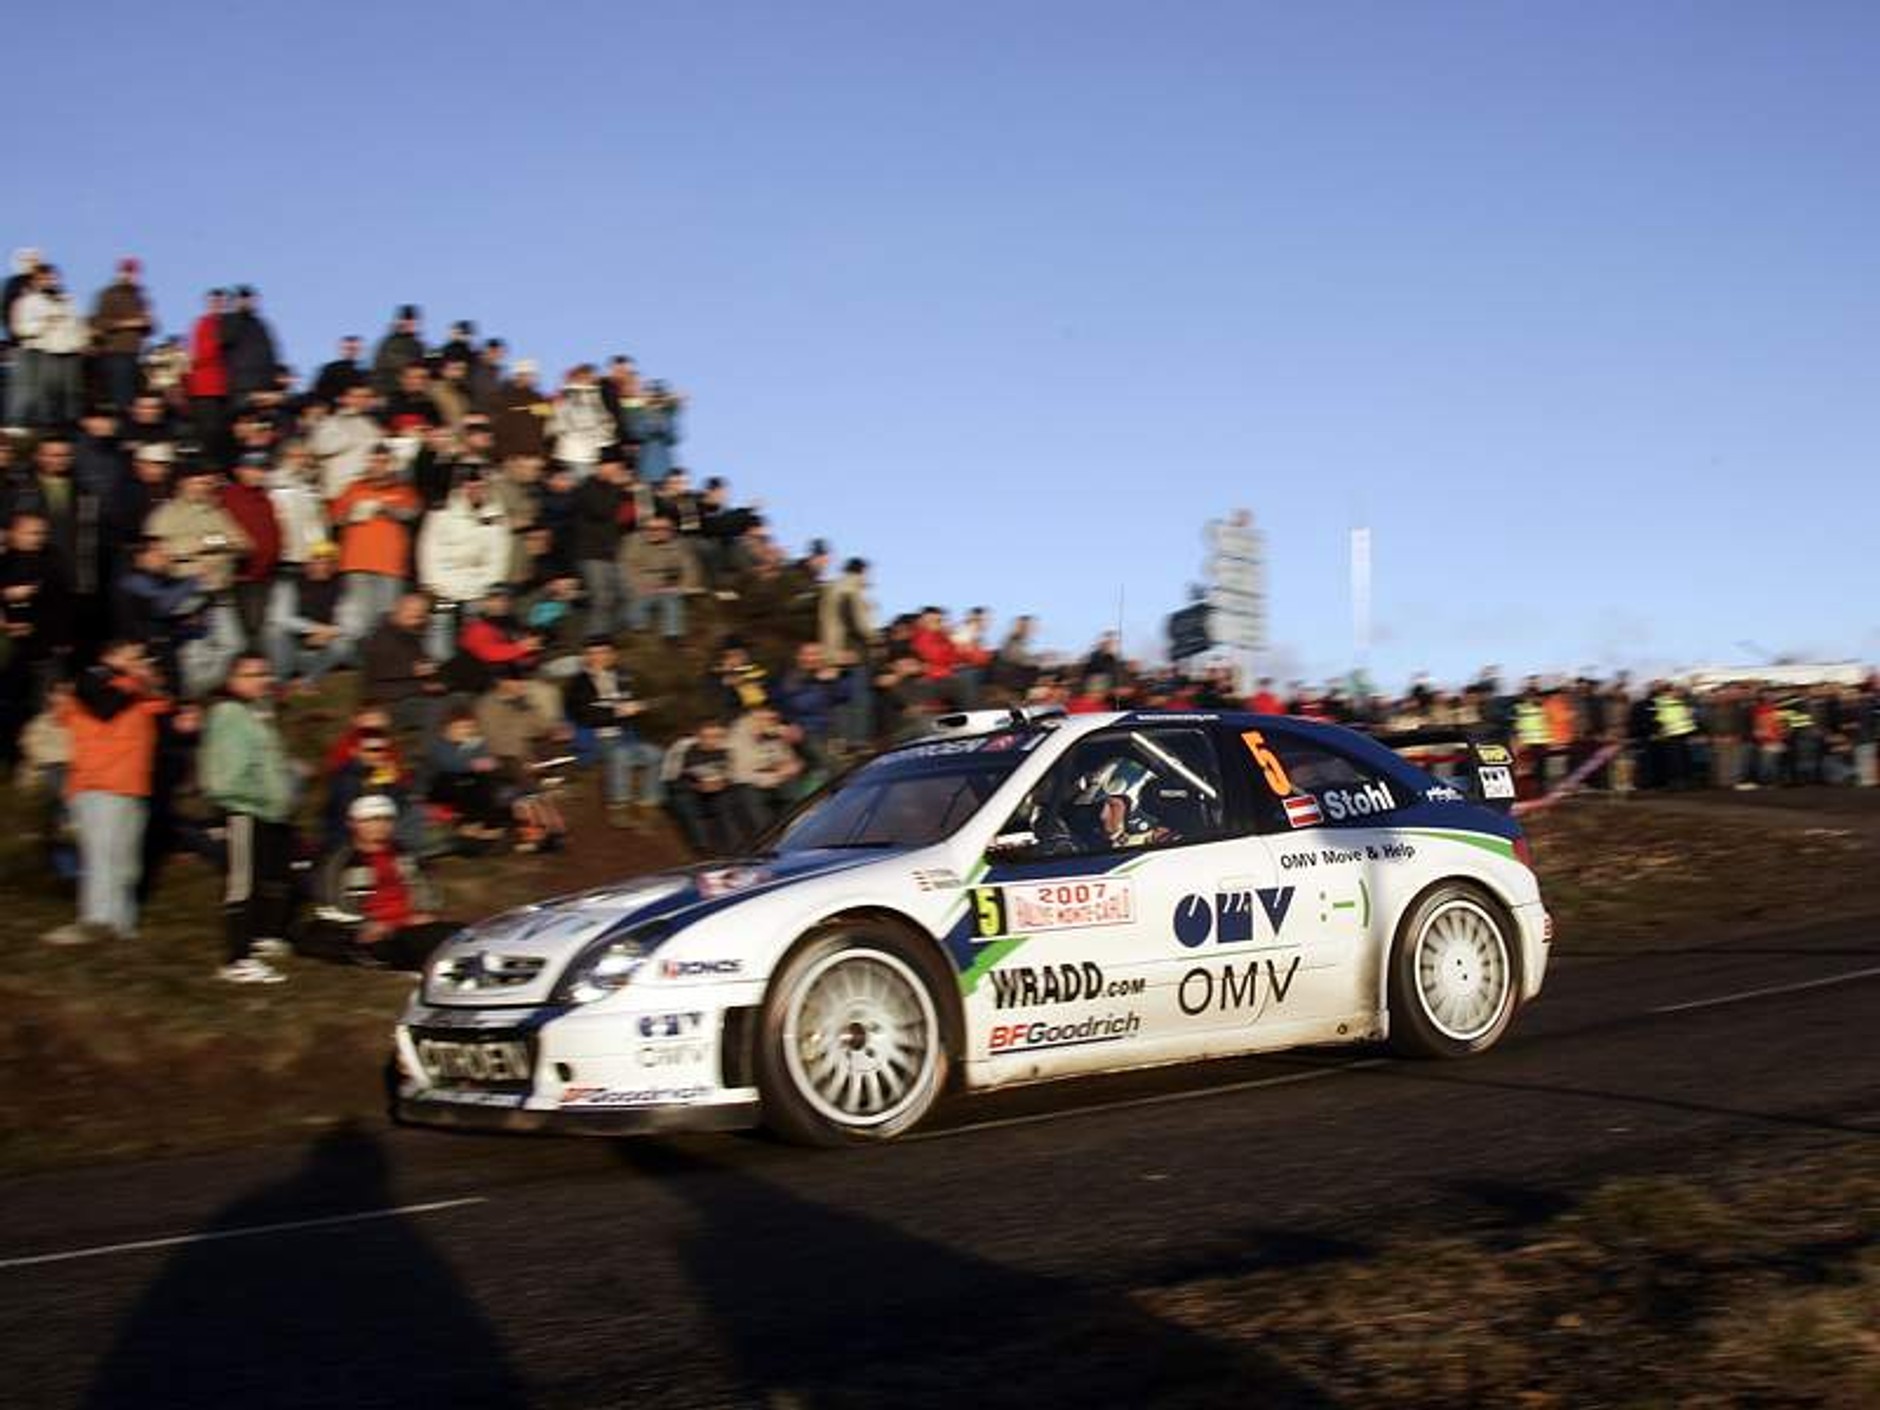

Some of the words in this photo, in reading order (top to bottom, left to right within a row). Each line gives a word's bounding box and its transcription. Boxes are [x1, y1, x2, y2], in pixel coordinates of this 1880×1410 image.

[1240, 731, 1293, 796] 5
[1323, 780, 1395, 820] Stohl
[1280, 853, 1317, 869] OMV
[1322, 849, 1362, 864] Move
[1381, 842, 1417, 860] Help
[976, 887, 1001, 937] 5
[1038, 883, 1107, 905] 2007
[1173, 885, 1296, 948] OMV
[1178, 956, 1301, 1015] OMV
[987, 1010, 1141, 1049] BFGoodrich
